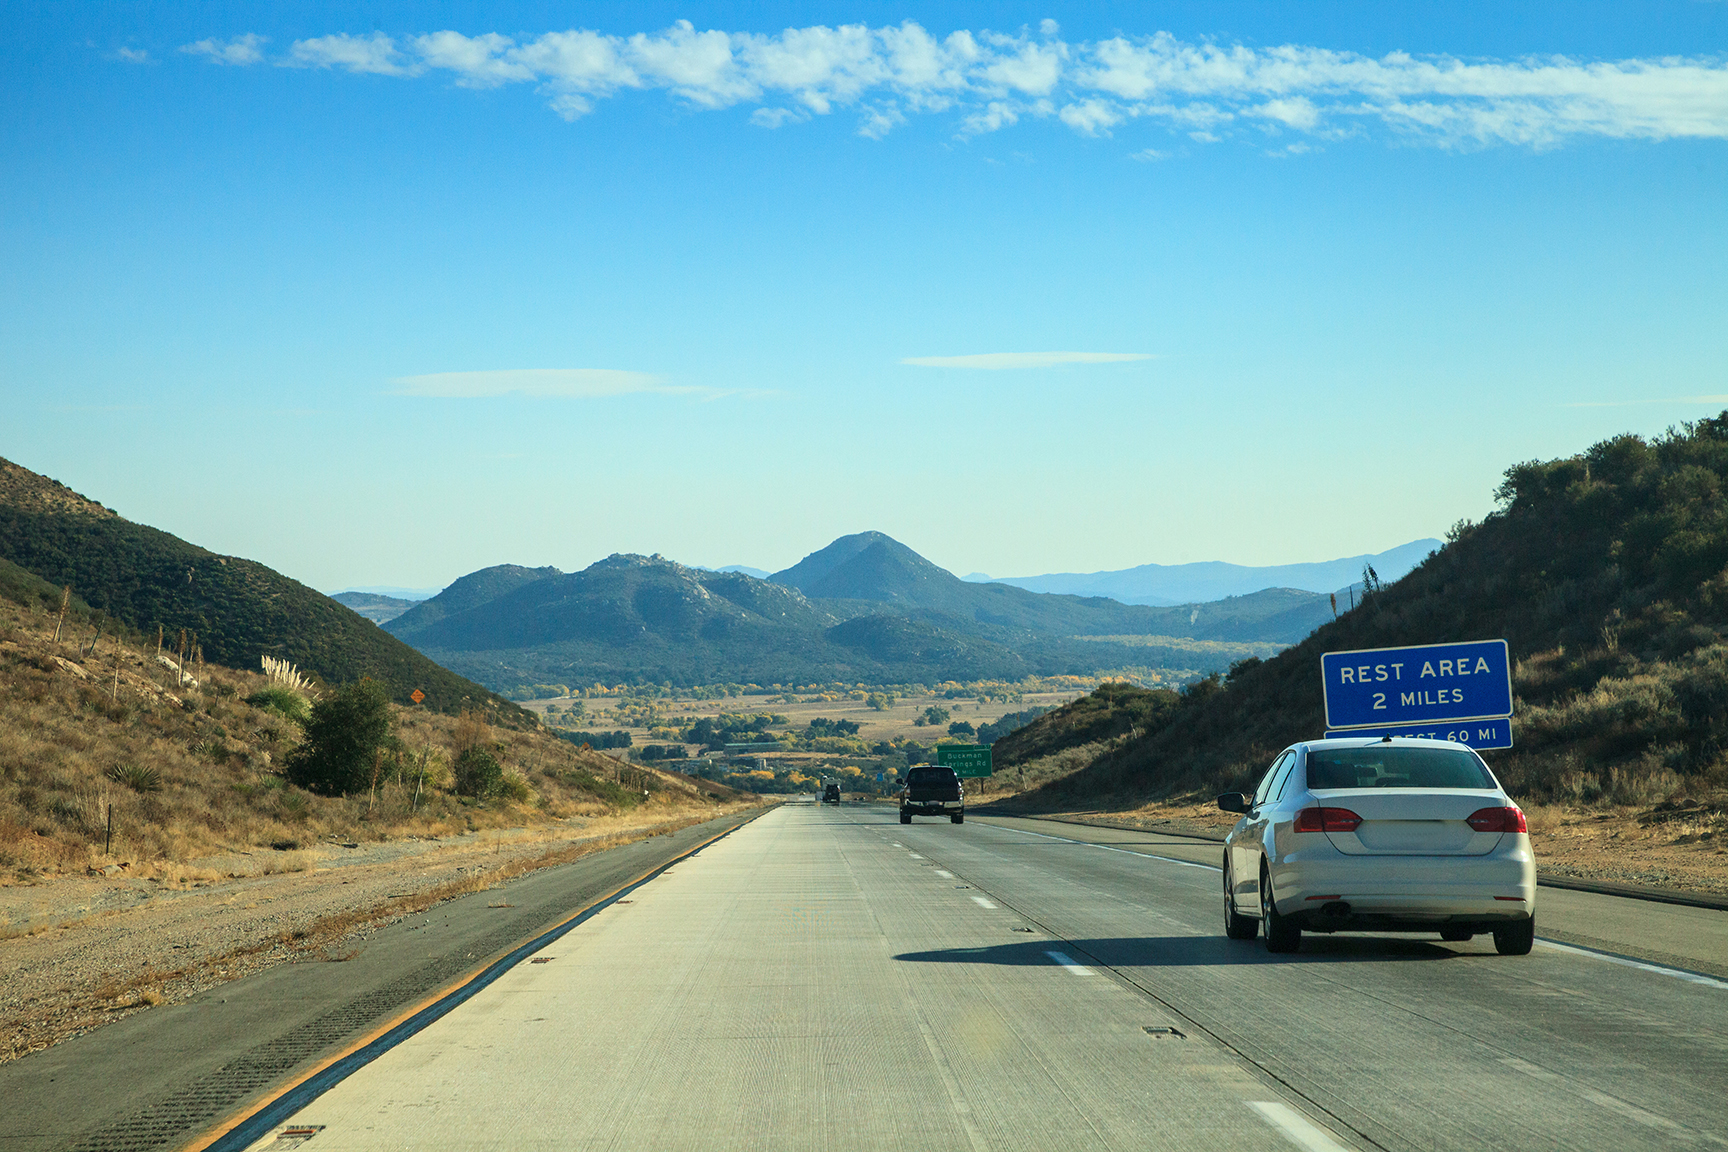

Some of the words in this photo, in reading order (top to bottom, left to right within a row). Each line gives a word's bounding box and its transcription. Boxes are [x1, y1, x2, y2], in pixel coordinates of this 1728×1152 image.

[1340, 663, 1404, 684] REST
[1420, 656, 1491, 679] AREA
[1373, 692, 1387, 710] 2
[1401, 688, 1464, 707] MILES
[1447, 730, 1469, 743] 60
[1478, 728, 1497, 741] MI
